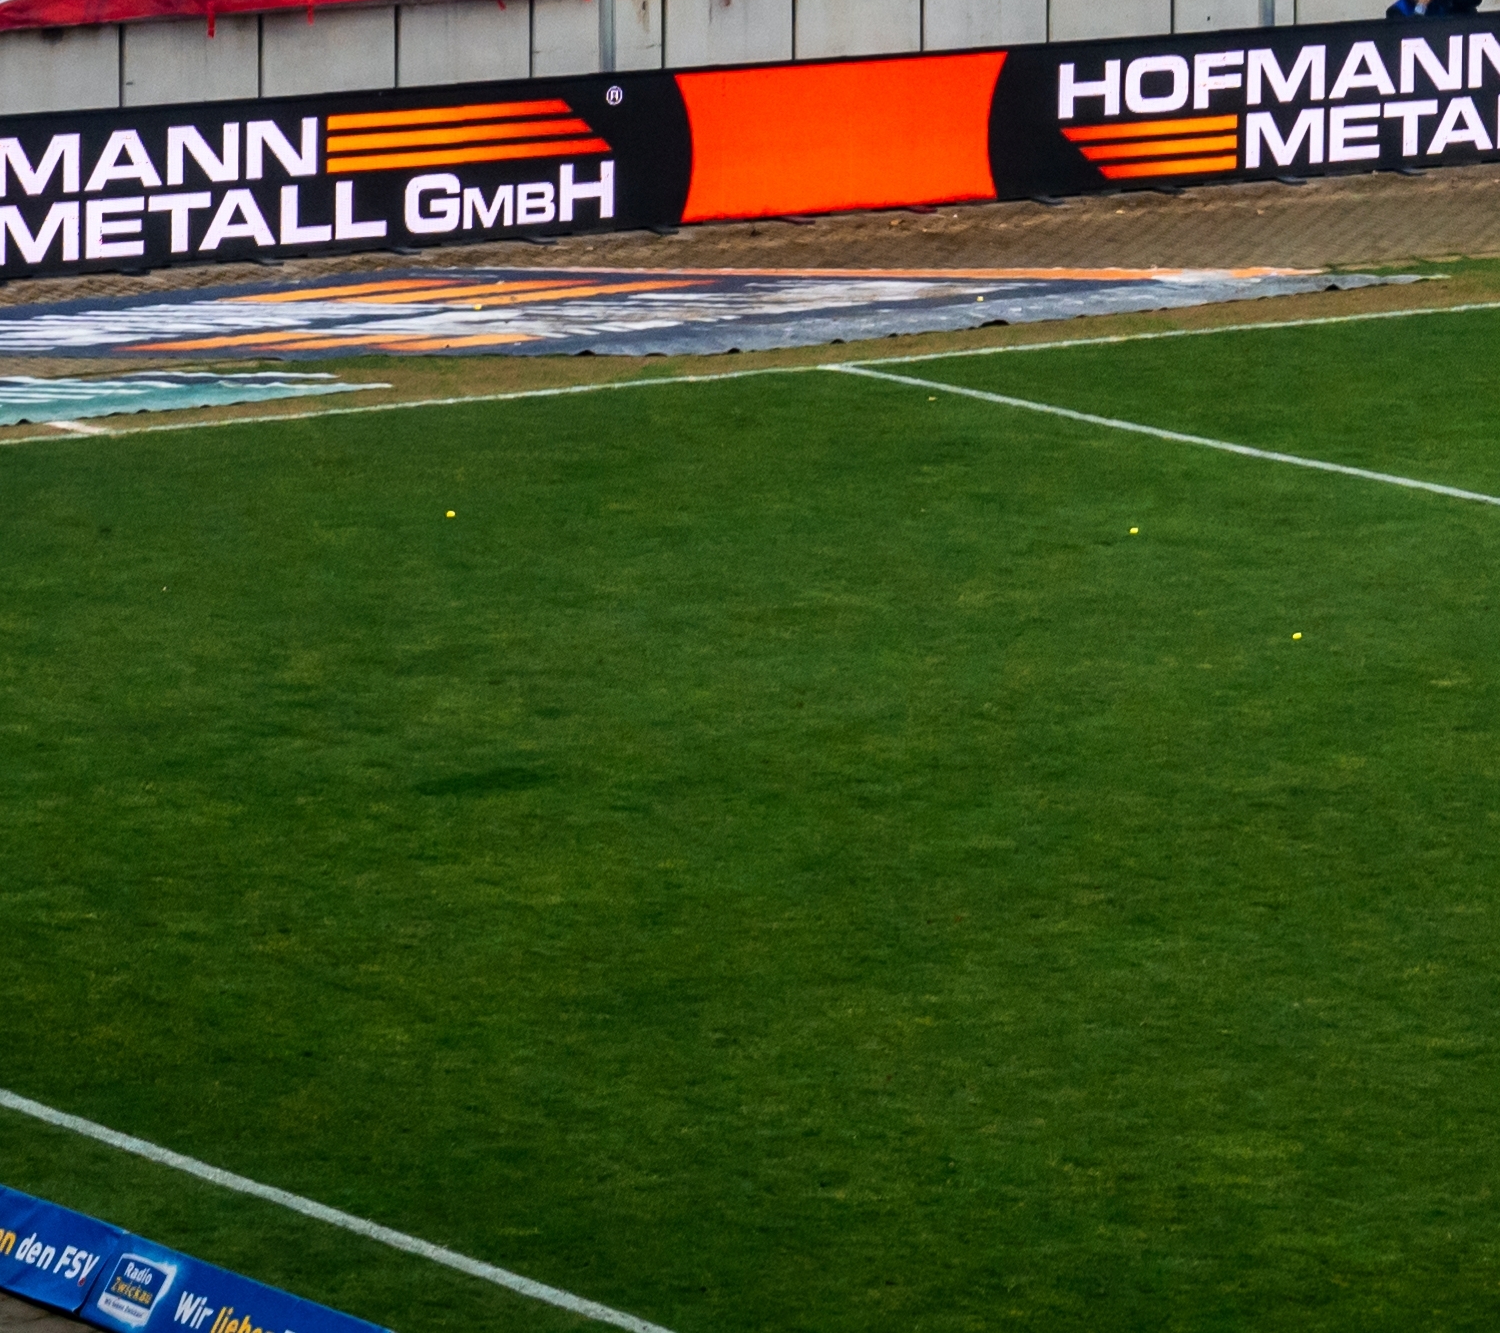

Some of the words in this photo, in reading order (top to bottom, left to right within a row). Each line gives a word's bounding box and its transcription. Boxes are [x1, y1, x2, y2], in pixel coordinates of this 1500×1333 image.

[14, 1232, 57, 1271] den
[52, 1244, 101, 1281] FSV
[123, 1261, 154, 1286] Radio
[110, 1276, 154, 1306] Zwickau
[173, 1290, 215, 1330] Wir
